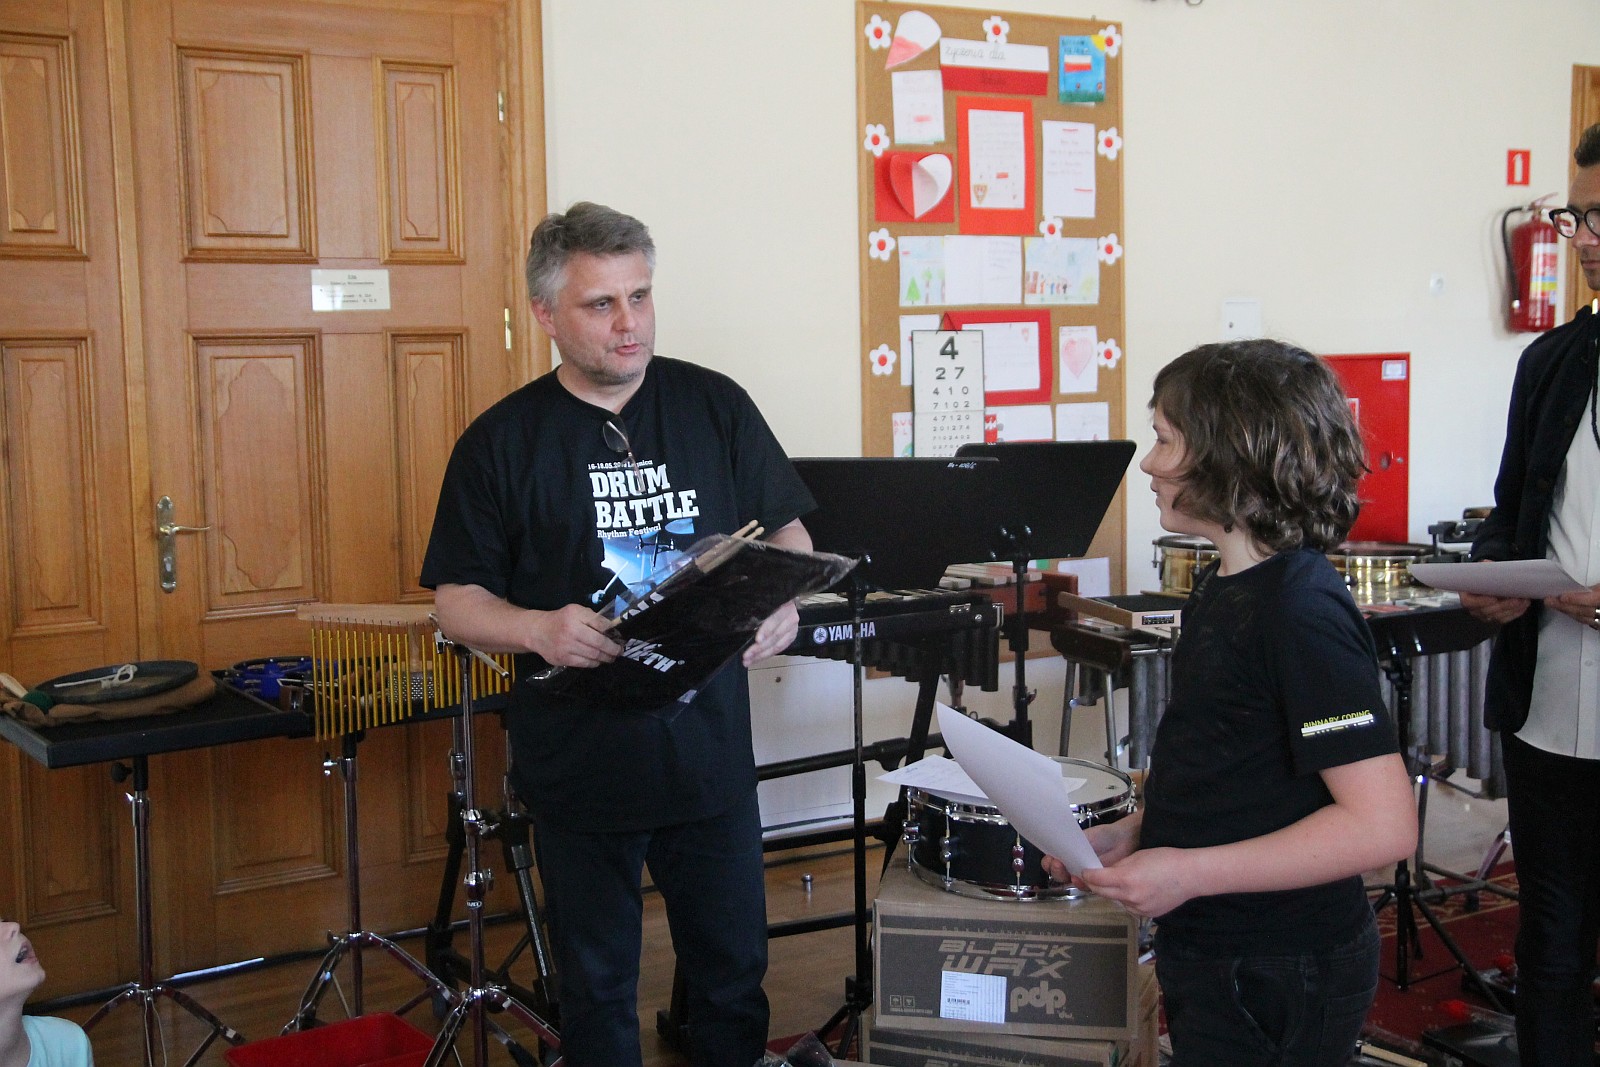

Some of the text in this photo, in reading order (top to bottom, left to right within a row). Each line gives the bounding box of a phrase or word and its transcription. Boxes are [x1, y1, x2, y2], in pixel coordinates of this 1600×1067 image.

[939, 335, 959, 360] 4
[589, 464, 670, 498] DRUM
[595, 489, 699, 528] BATTLE
[597, 523, 661, 539] Rhythm Festival
[828, 621, 876, 641] YAMHA
[1341, 709, 1371, 721] CODING
[938, 939, 1073, 959] BLACK
[941, 954, 1071, 979] WAX
